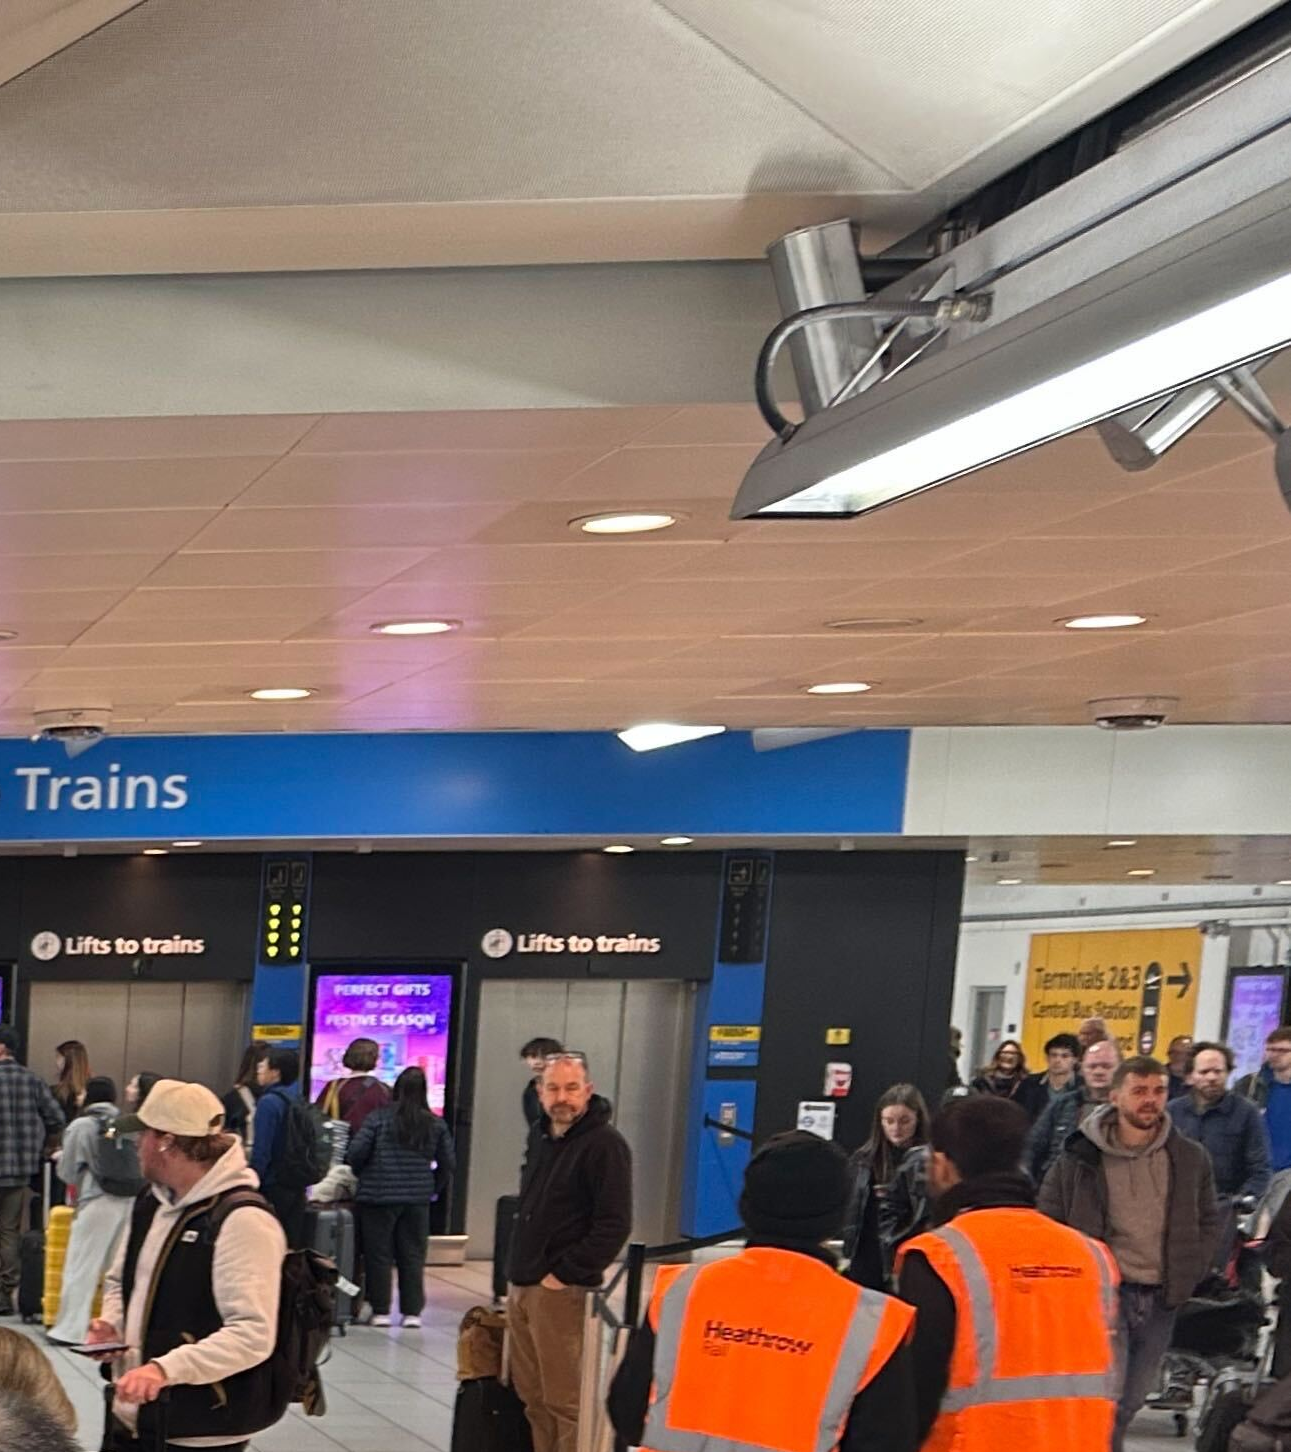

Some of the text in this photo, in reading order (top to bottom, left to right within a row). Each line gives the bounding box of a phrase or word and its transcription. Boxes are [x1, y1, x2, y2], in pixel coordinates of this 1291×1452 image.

[15, 763, 188, 812] Trains
[65, 935, 205, 954] Lifts to trains
[517, 933, 661, 953] Lifts to trains
[1034, 965, 1142, 991] Terminals 2&3
[333, 983, 431, 996] PERFECT GIFTS
[1032, 1000, 1138, 1019] Central Bus Station
[380, 1013, 436, 1026] SEASON
[704, 1320, 814, 1355] Heathrow
